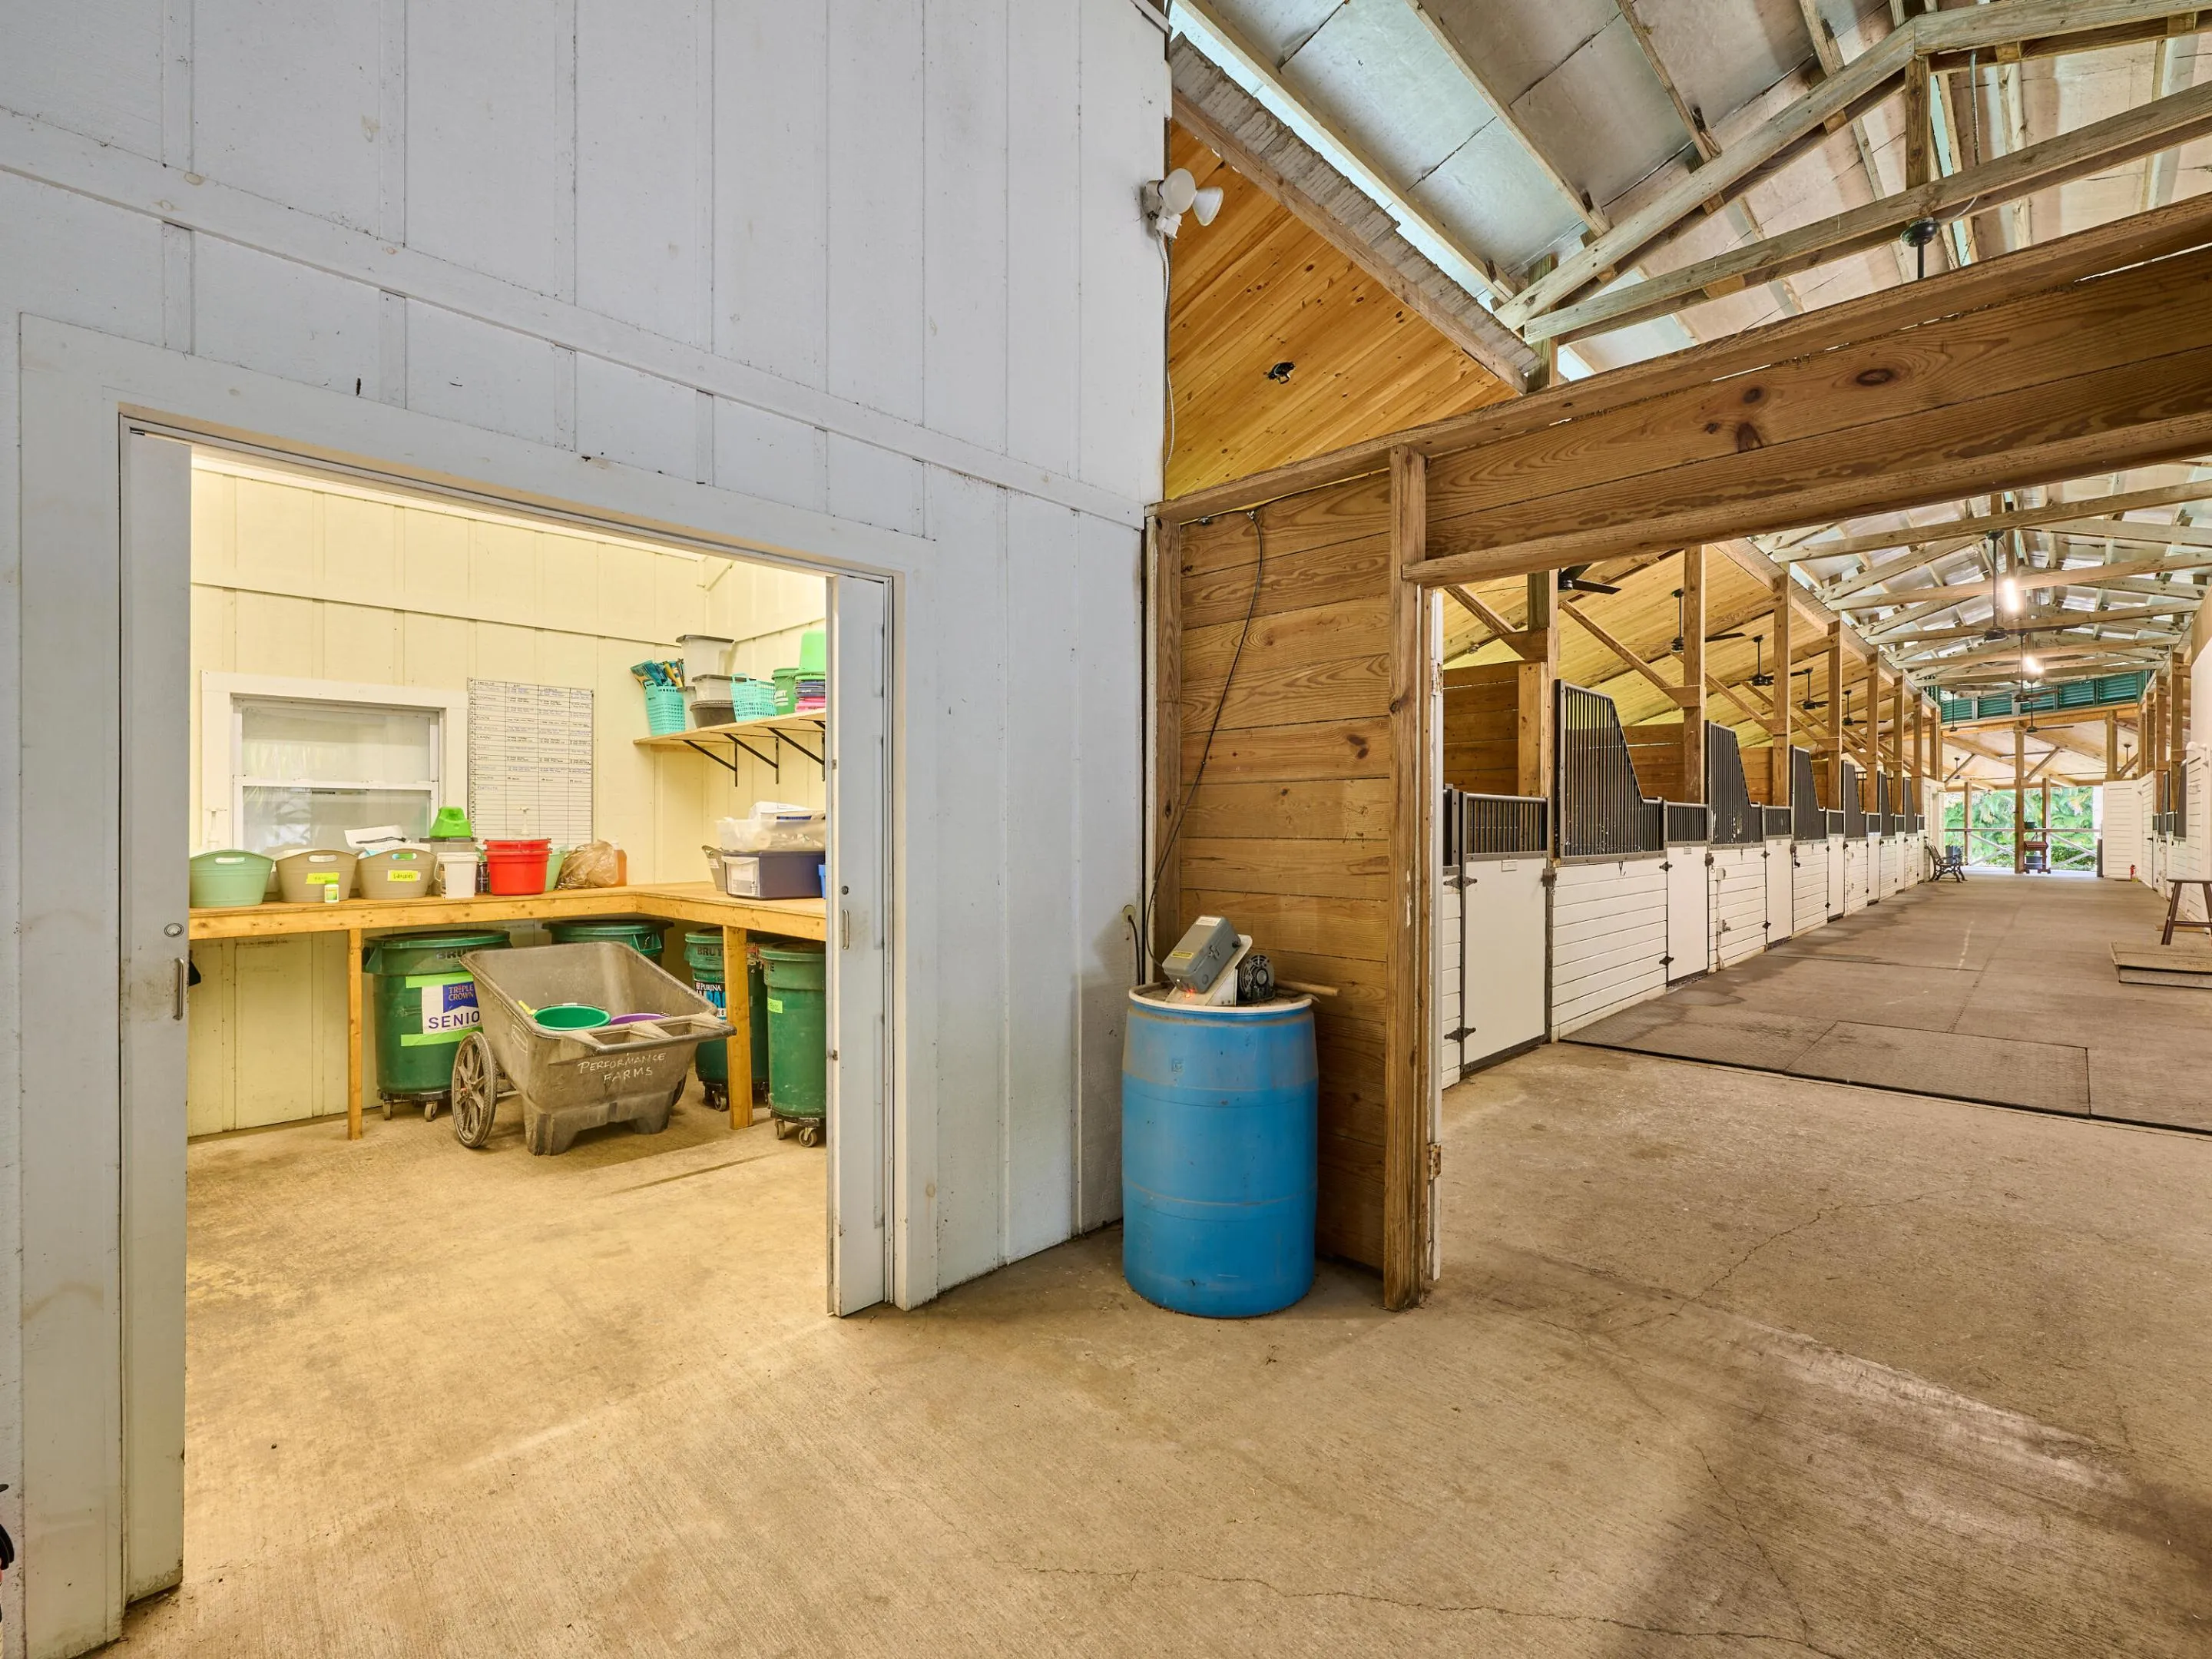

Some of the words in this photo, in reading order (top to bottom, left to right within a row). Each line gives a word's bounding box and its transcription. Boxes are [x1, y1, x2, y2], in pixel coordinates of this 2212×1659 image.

[448, 984, 475, 995] TRIPLE
[700, 982, 722, 992] PURINA
[448, 992, 475, 1002] CROWN
[577, 1053, 667, 1074] PERFORMANCE
[603, 1066, 653, 1084] FARMS
